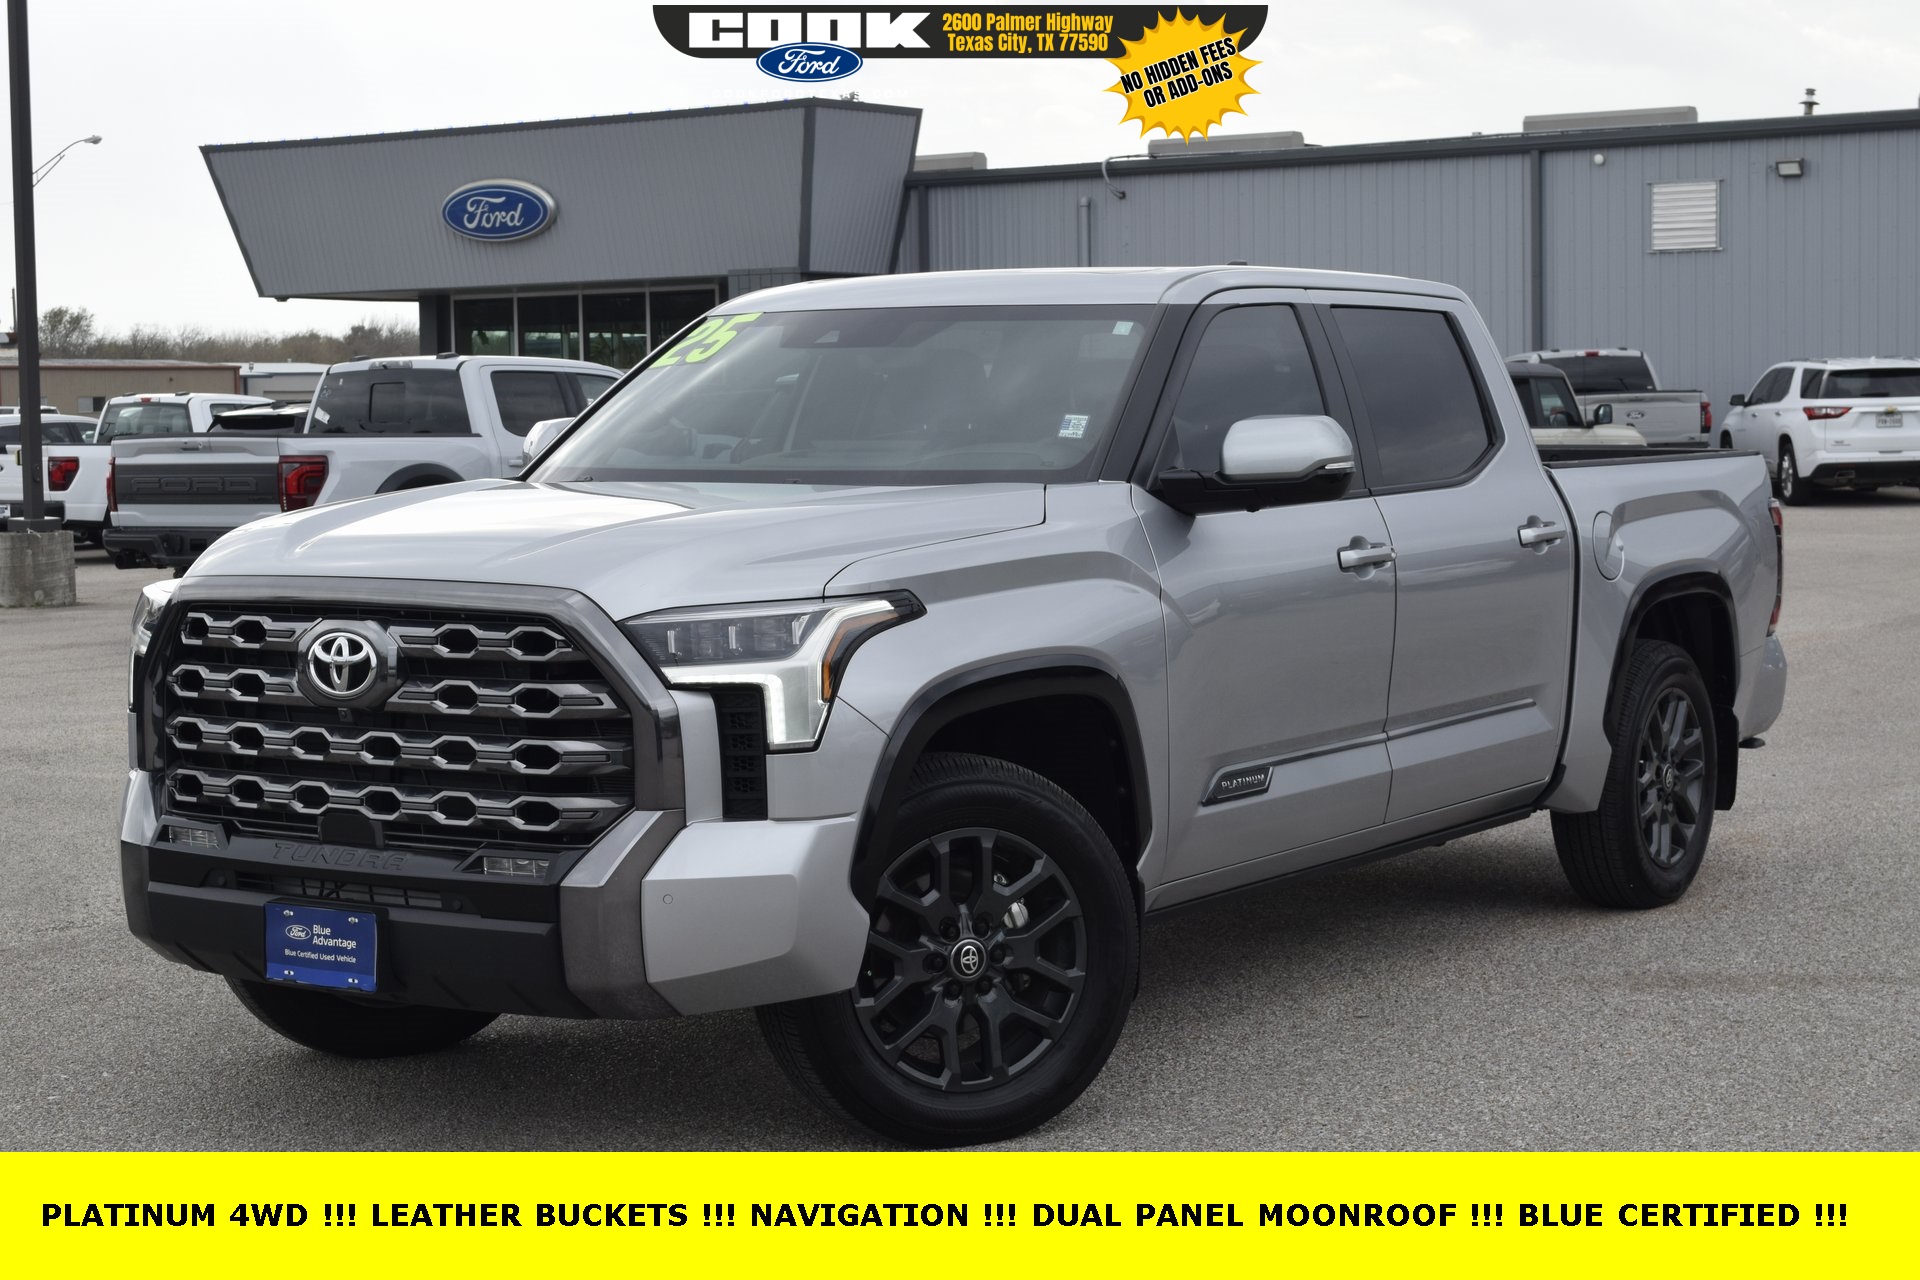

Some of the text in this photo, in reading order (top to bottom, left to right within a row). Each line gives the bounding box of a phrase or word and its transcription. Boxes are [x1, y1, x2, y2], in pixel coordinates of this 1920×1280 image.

[463, 196, 524, 229] Ford
[648, 312, 763, 369] 25
[131, 477, 257, 492] FORD
[1221, 774, 1265, 790] PLATINUM
[272, 842, 408, 871] TUNDRA
[289, 926, 307, 938] Ford
[312, 924, 331, 935] Blue
[312, 936, 357, 949] Advantage
[297, 950, 318, 960] Certified
[319, 953, 335, 961] Used
[336, 954, 357, 964] Vehicle
